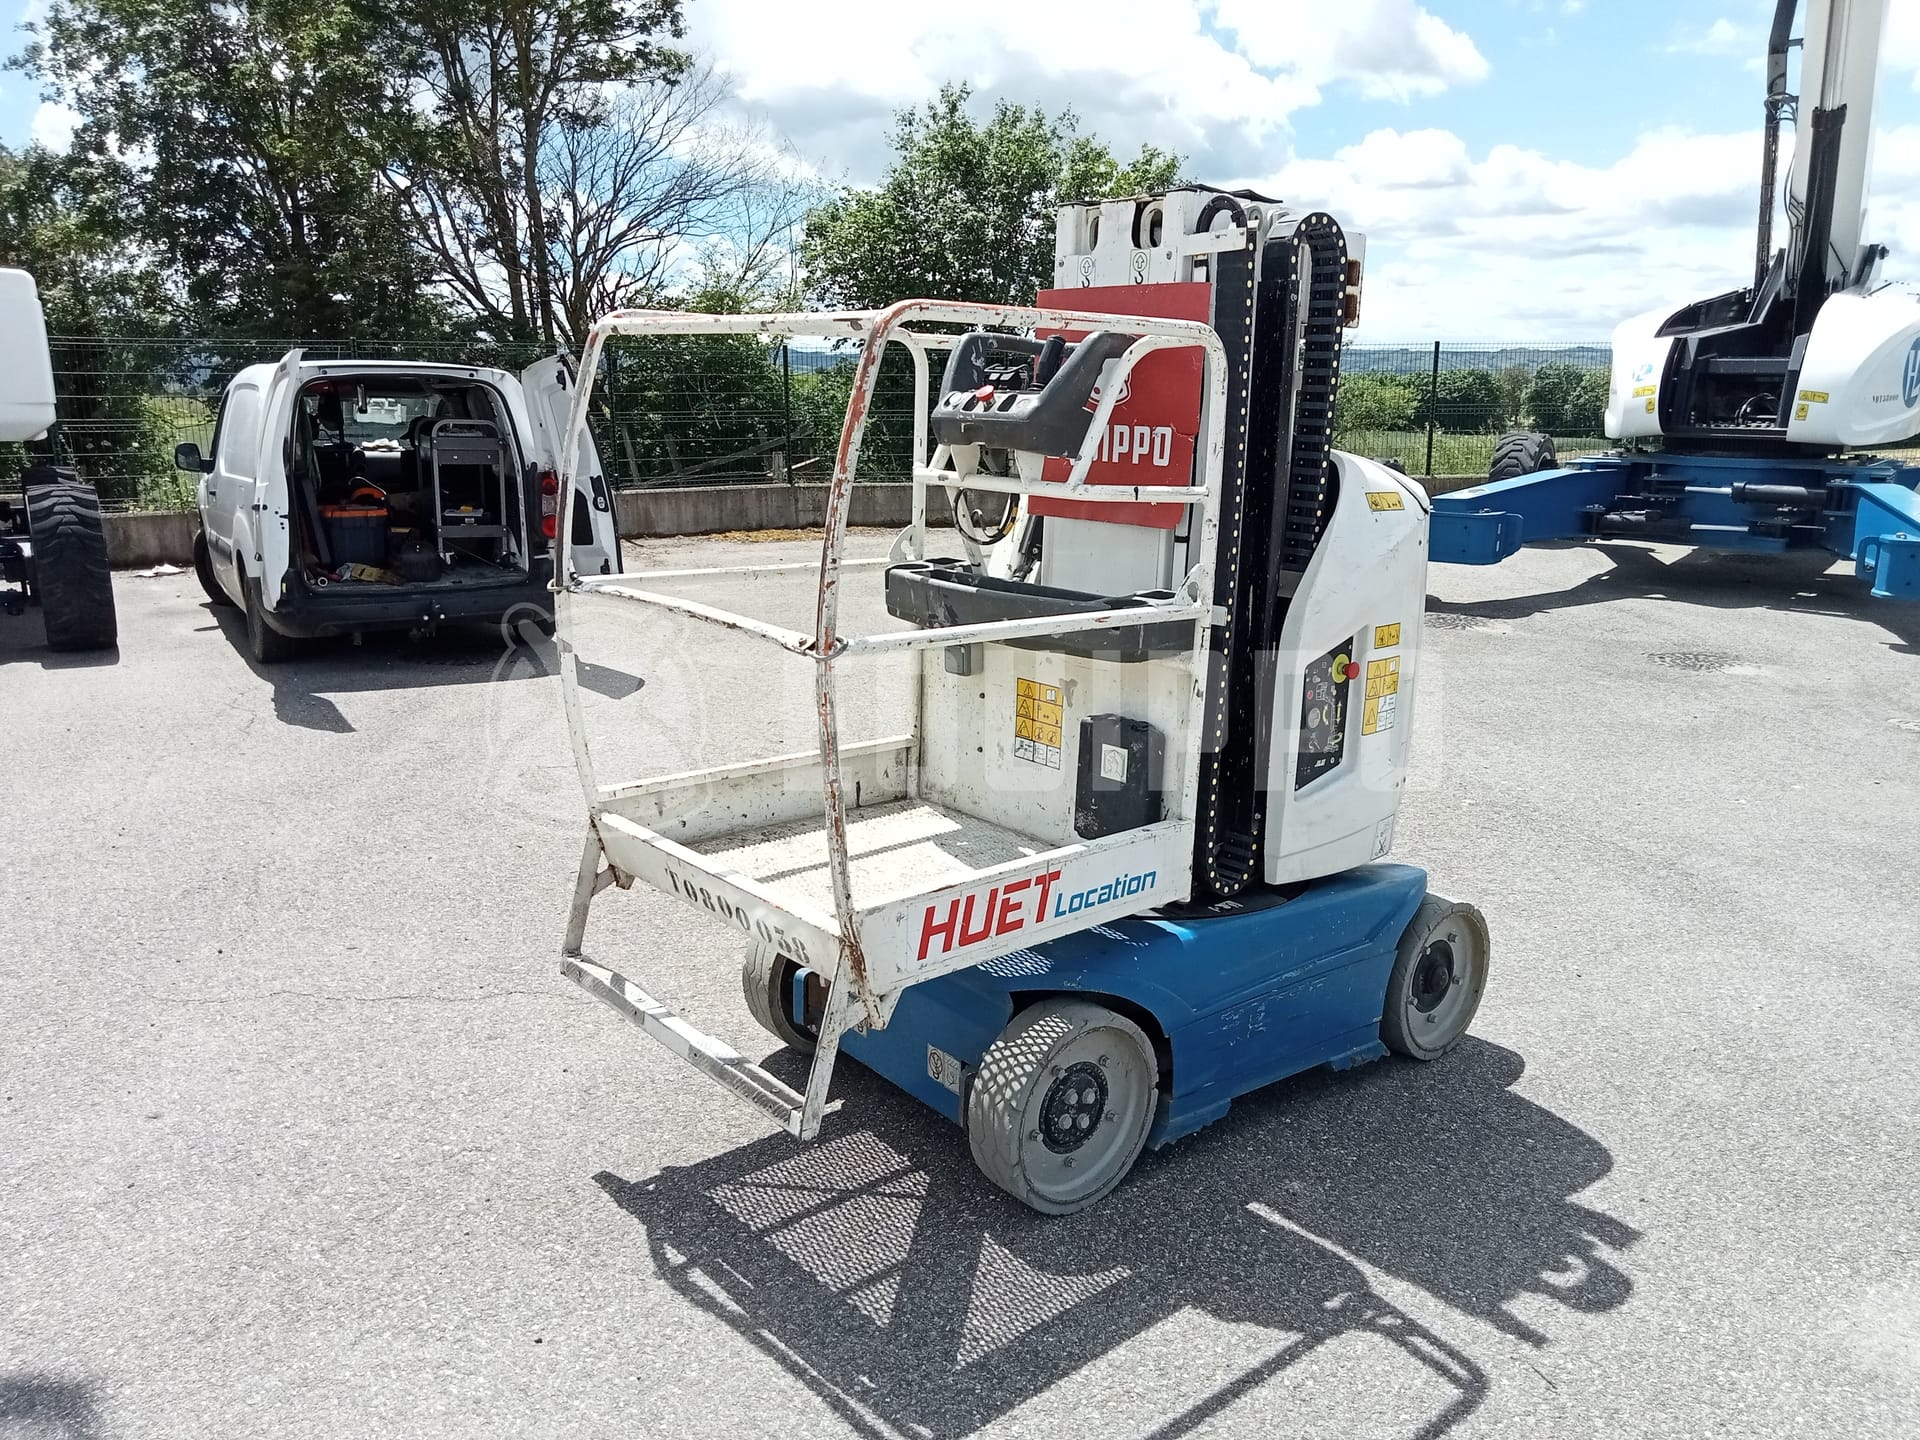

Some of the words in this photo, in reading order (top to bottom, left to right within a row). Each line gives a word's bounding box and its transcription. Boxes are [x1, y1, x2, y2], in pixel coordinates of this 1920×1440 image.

[1047, 425, 1173, 466] IPPO
[917, 870, 1061, 961] HUET
[1054, 870, 1156, 918] Location
